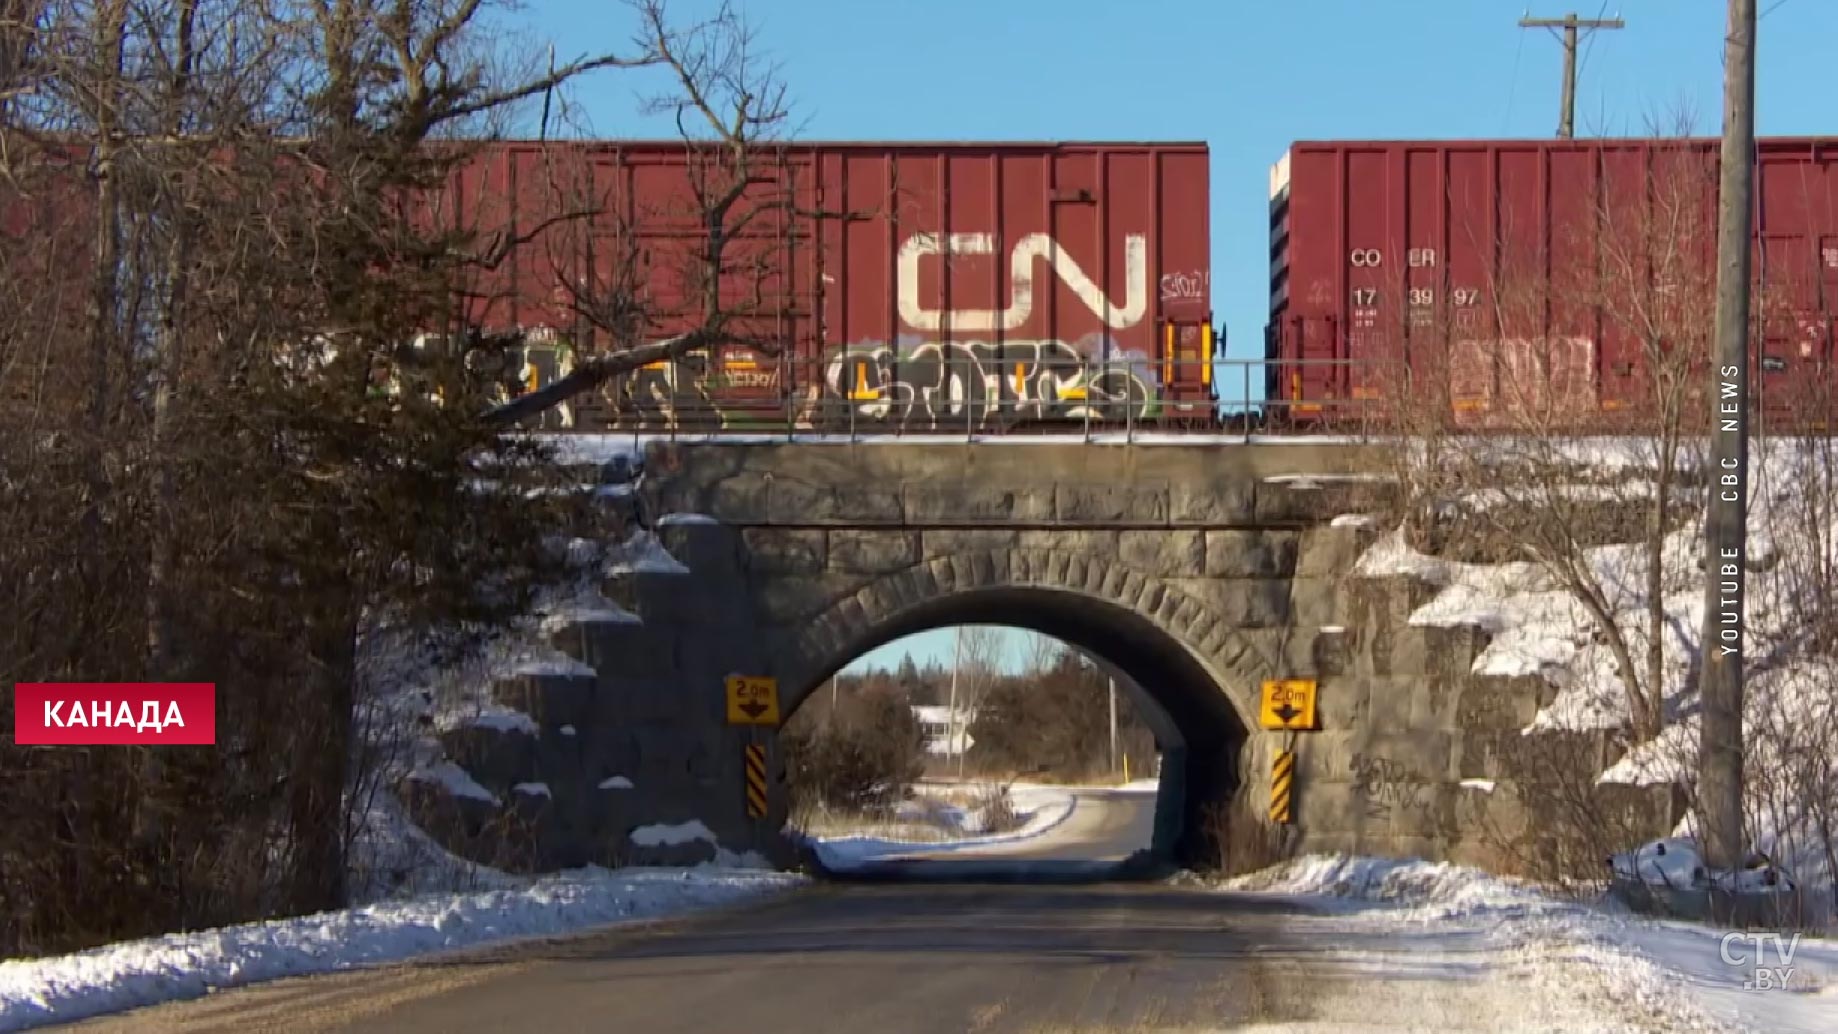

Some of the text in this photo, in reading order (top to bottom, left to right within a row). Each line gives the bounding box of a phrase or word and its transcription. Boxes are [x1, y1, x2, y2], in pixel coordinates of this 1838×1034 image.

[1350, 248, 1382, 268] CO
[898, 231, 1147, 330] CN
[1353, 287, 1479, 306] 17 39 97
